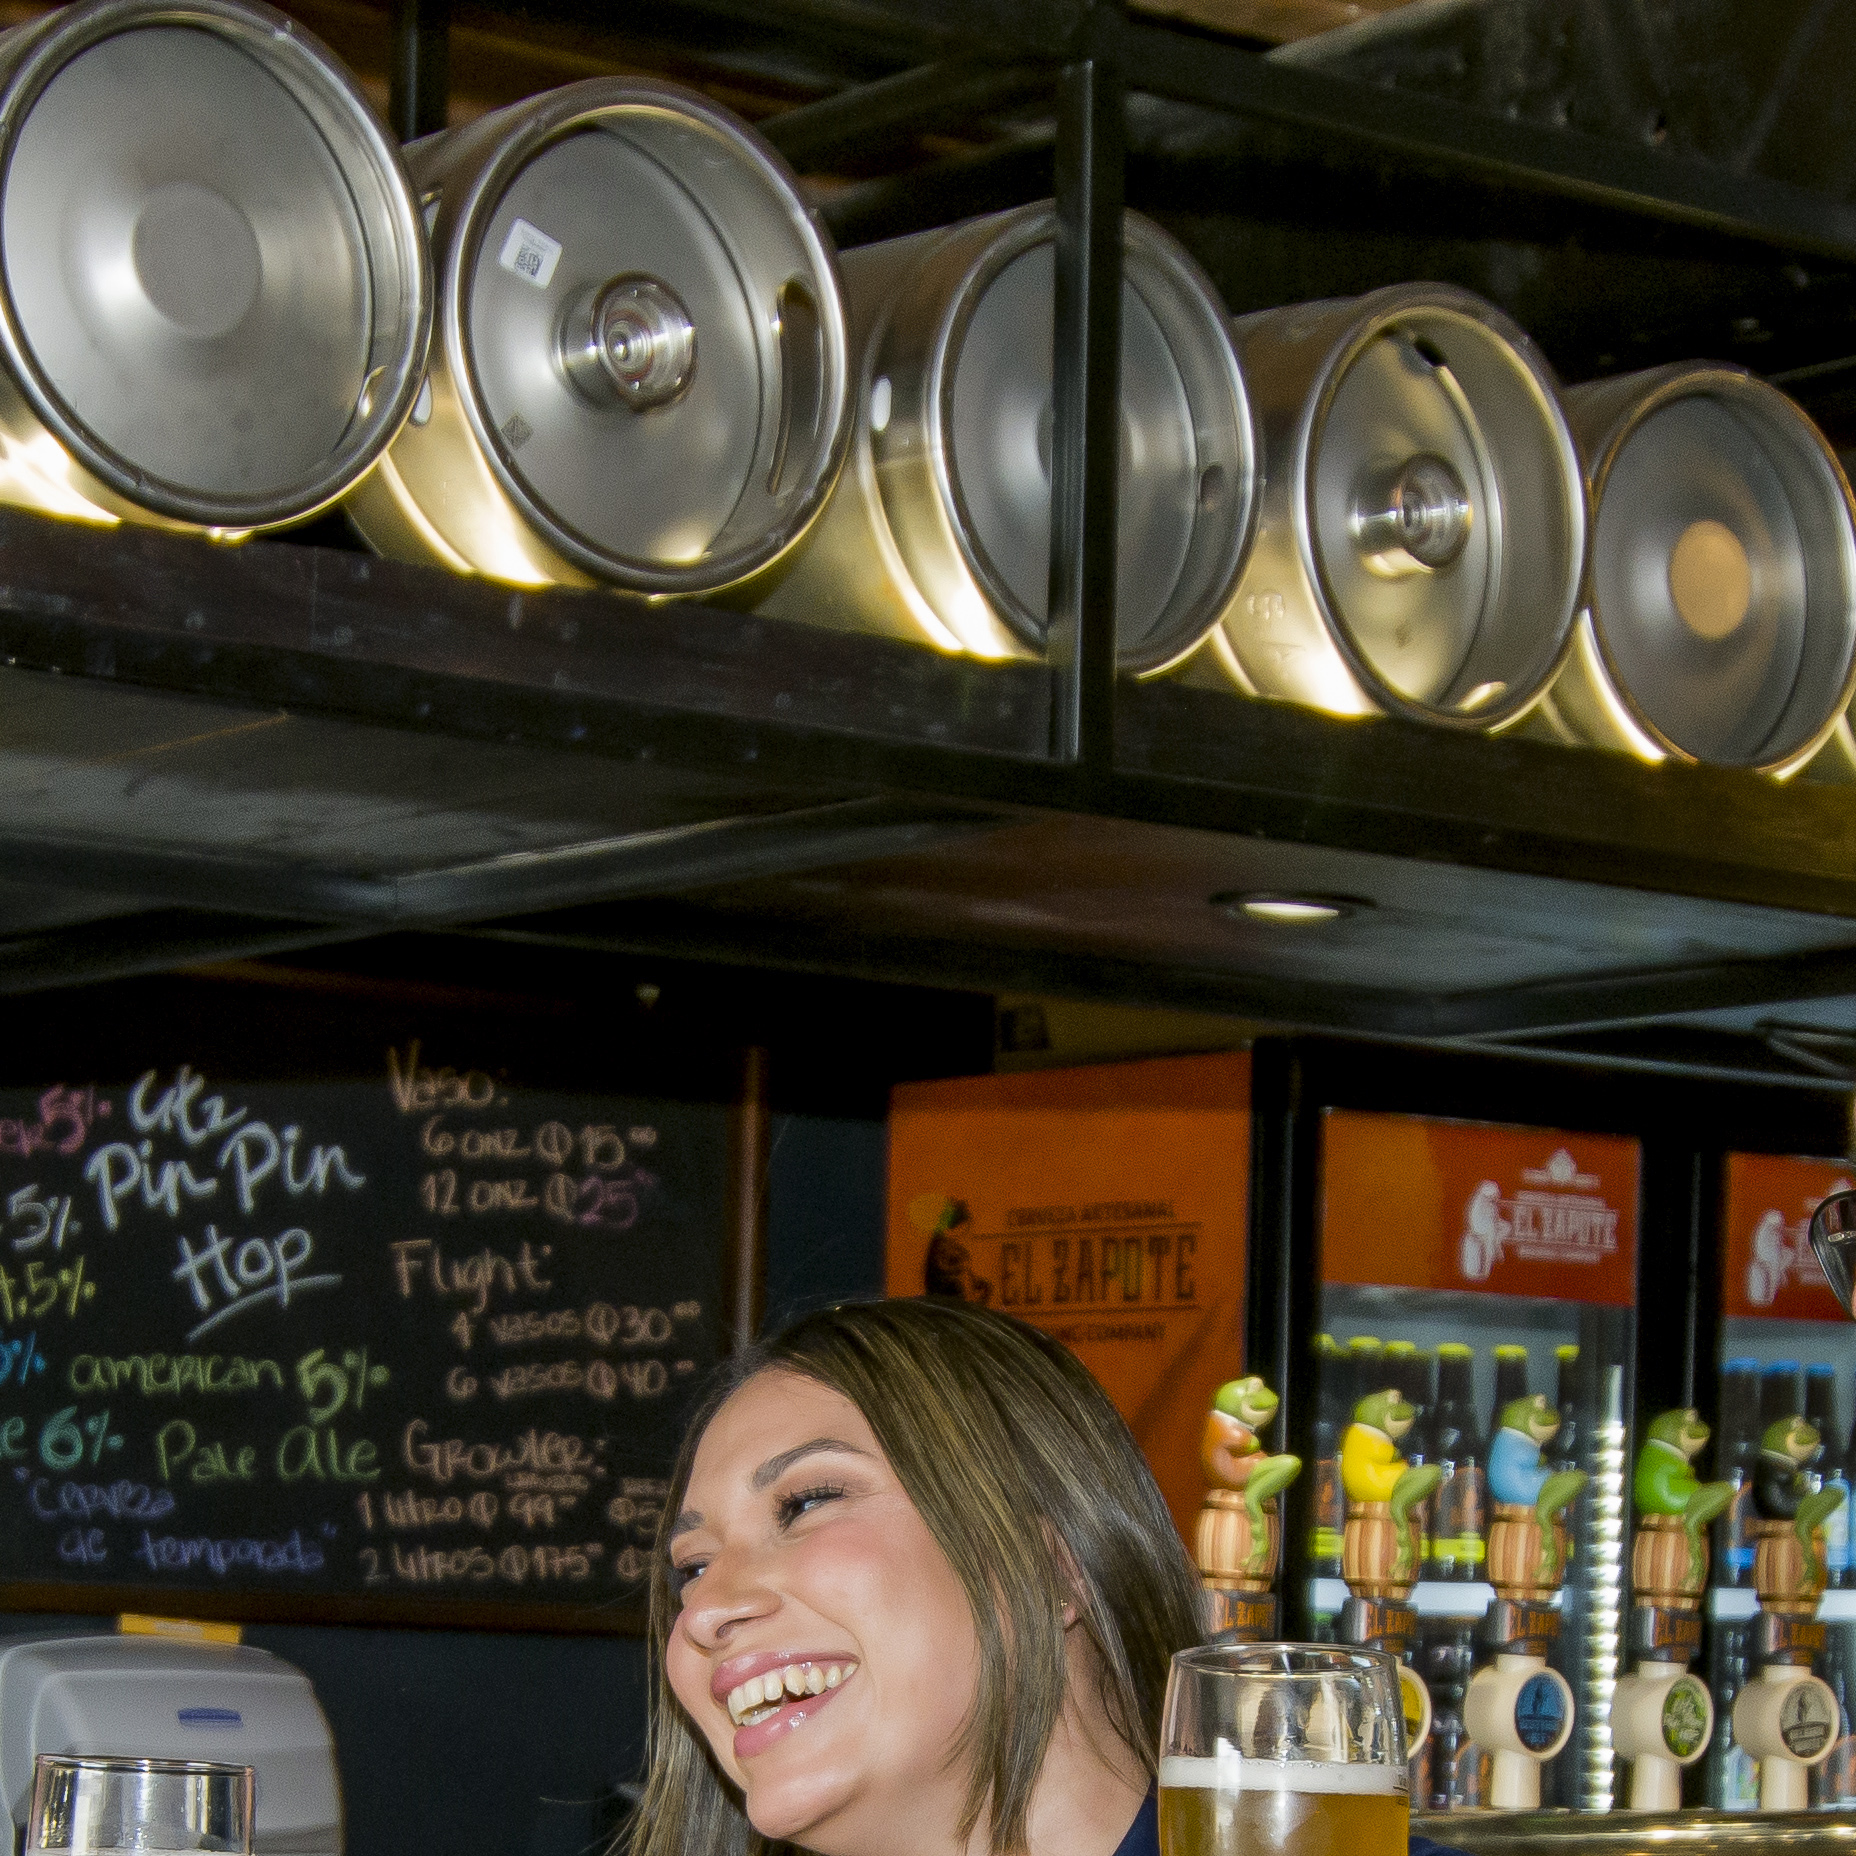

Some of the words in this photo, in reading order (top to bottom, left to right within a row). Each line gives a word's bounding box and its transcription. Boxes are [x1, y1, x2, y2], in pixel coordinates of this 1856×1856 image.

[127, 1064, 248, 1147] Utz
[83, 1138, 218, 1232] Pin
[216, 1120, 367, 1214] Pin
[7, 1182, 83, 1252] 5%
[171, 1223, 313, 1310] Hop
[1000, 1241, 1042, 1307] EL
[1052, 1233, 1198, 1304] ZAPOTE
[296, 1344, 392, 1425] 5%
[40, 1404, 125, 1471] 6%
